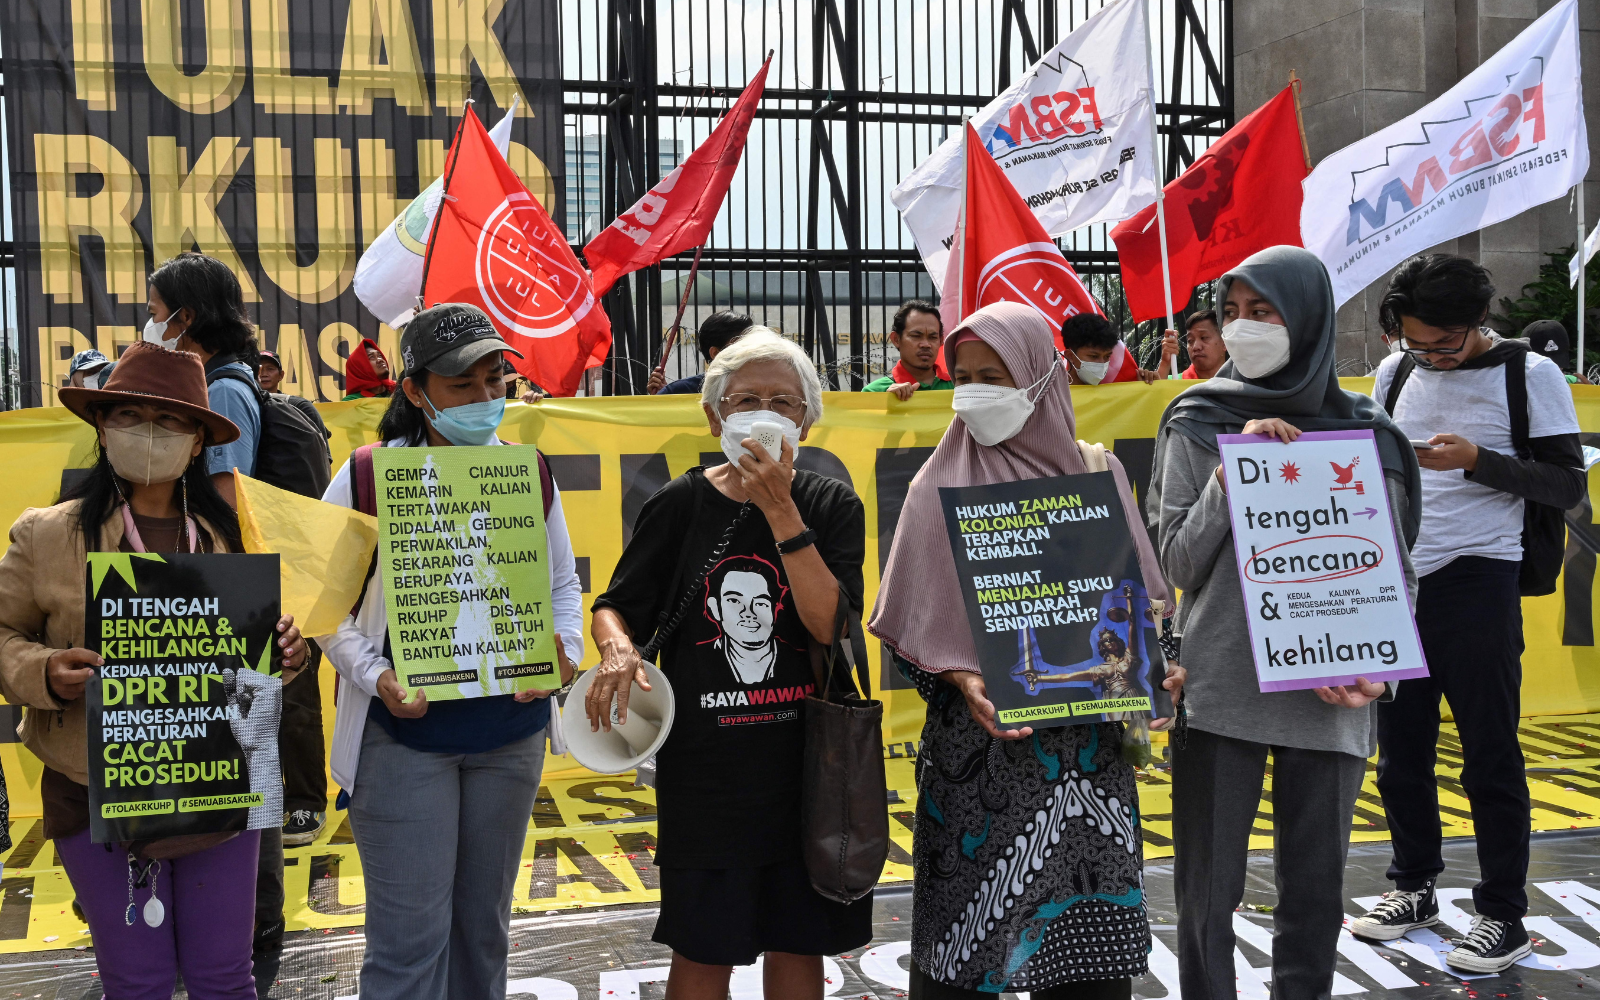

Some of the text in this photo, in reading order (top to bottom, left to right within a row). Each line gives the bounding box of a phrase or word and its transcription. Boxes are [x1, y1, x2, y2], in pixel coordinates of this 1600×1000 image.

[506, 277, 541, 308] IUL
[385, 464, 530, 482] GEMPA CIANJUR
[1237, 457, 1270, 484] Di
[386, 481, 531, 500] KEMARIN KALIAN
[387, 500, 491, 517] TERTAWAKAN
[955, 494, 1083, 520] HUKUM ZAMAN
[1244, 496, 1349, 534] tengah
[389, 516, 535, 535] DIDALAM GEDUNG
[958, 505, 1110, 533] KOLONIAL KALIAN
[390, 535, 492, 554] PERWAKILAN,
[961, 526, 1051, 547] TERAPKAN
[392, 550, 538, 572] SEKARANG KALIAN
[965, 542, 1043, 561] KEMBALI.
[1250, 545, 1379, 575] bencana
[394, 572, 474, 589] BERUPAYA
[973, 569, 1042, 590] BERNIAT
[976, 576, 1114, 604] MENJAJAH SUKU
[396, 587, 510, 607] MENGESAHKAN
[1287, 586, 1396, 601] KEDUA KALINYA DPR
[1288, 594, 1398, 610] MENGESAHKAN PERATURAN
[101, 597, 219, 617] DI TENGAH
[397, 602, 542, 625] RKUHP DISAAT
[980, 594, 1081, 619] DAN DARAH
[1260, 591, 1282, 621] &
[1290, 608, 1359, 619] CACAT PROSEDUR!
[101, 617, 234, 638] BENCANA &
[985, 607, 1099, 633] SENDIRI KAH?
[400, 619, 544, 643] RAKYAT BUTUH
[101, 637, 247, 659] KEHILANGAN
[402, 638, 535, 661] BANTUAN KALIAN?
[1265, 633, 1399, 668] kehilang
[100, 662, 219, 678] KEDUA KALINYA
[410, 664, 551, 685] #SEMUABISAKENA #TOLAKRKUHP
[102, 674, 209, 706] DPR RI
[700, 683, 815, 709] #SAYAWAWAN
[102, 705, 239, 726] MENGESAHKAN
[720, 711, 796, 725] sayawawan.com
[1003, 699, 1148, 719] #TOLAKRKUHP #SEMUABISAKENA
[103, 723, 207, 742] PERATURAN
[103, 740, 187, 764] CACAT
[104, 759, 240, 788] PROSEDUR!
[105, 795, 261, 814] #TOLAKRKUHP #SEMUABISAKENA
